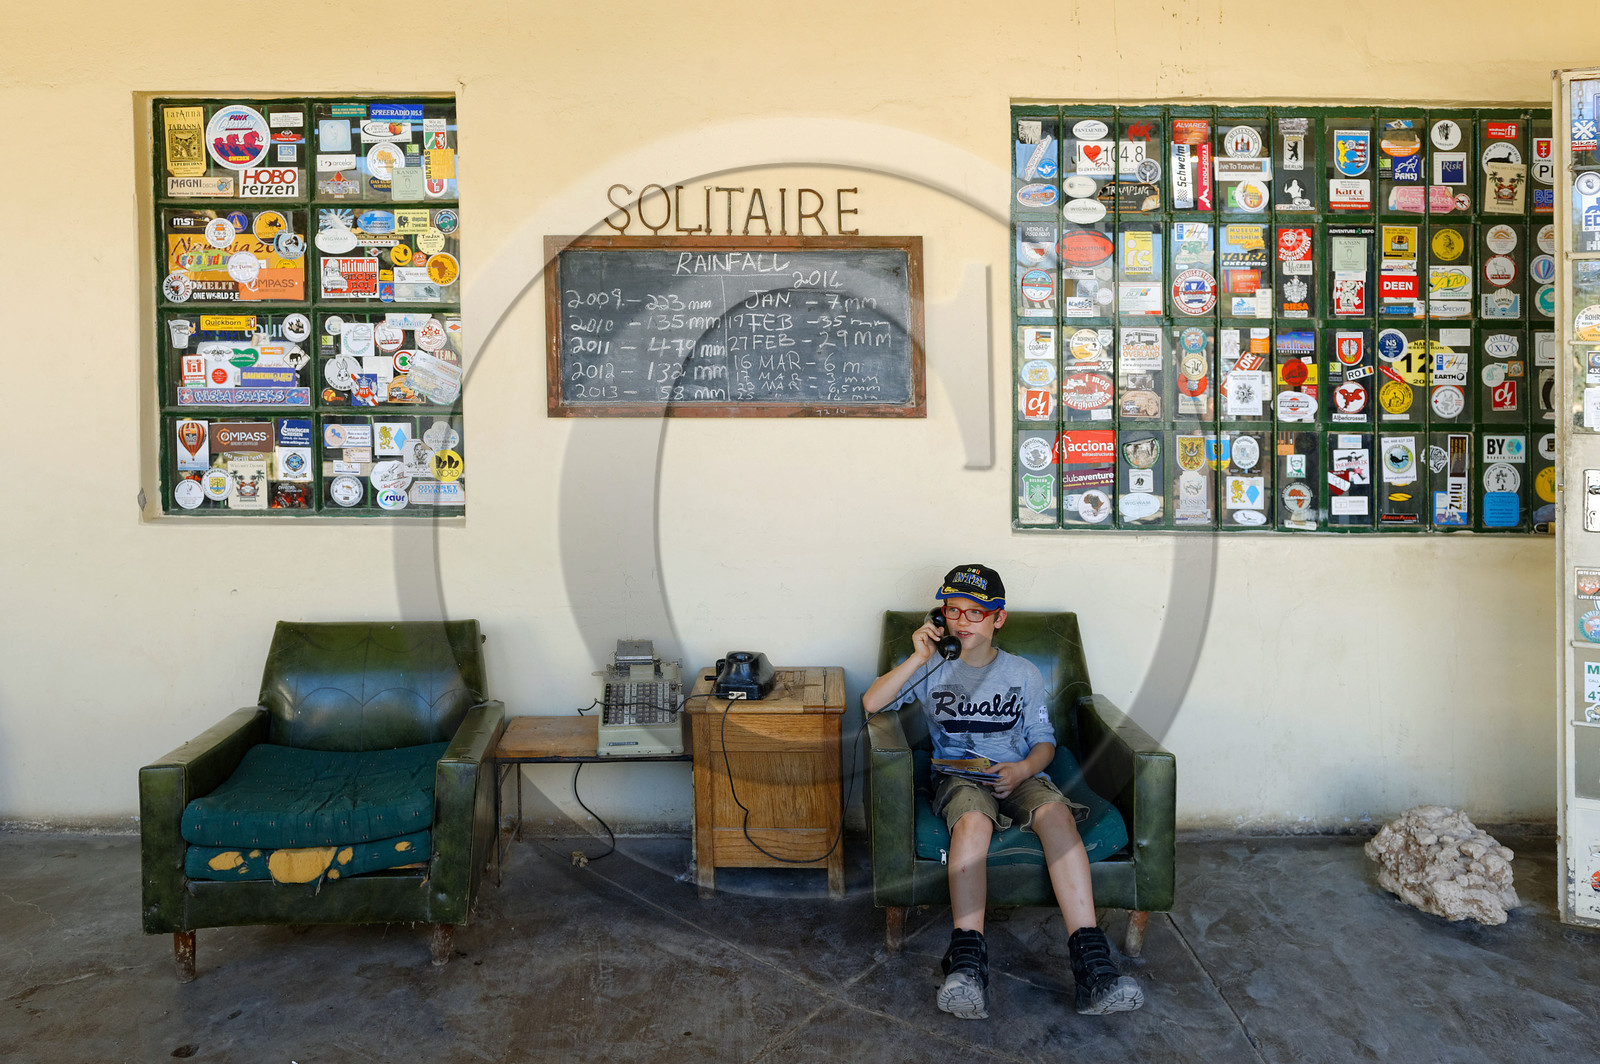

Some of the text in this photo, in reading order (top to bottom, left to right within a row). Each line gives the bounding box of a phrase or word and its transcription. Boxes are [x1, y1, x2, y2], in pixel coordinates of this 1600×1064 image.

[1177, 145, 1187, 187] Schwelm
[1442, 162, 1462, 172] Risk
[171, 179, 202, 189] MAGNI
[243, 170, 296, 184] HOBO
[242, 185, 295, 195] reizen
[603, 184, 860, 235] SOLITAIRE
[173, 218, 194, 226] msi
[675, 251, 790, 274] RAINFALL
[1222, 253, 1266, 261] TATRA
[340, 260, 377, 272] latitudini
[792, 270, 843, 289] 2014
[1384, 281, 1413, 290] DEEN
[645, 294, 686, 311] 223
[688, 299, 712, 310] mm
[844, 298, 877, 312] mm
[569, 314, 721, 334] 2010 135 mm
[745, 314, 793, 332] FEB
[820, 315, 847, 329] 35
[728, 336, 747, 351] 27
[753, 334, 796, 350] FEB
[819, 330, 848, 348] 29
[1490, 335, 1516, 343] OVALIE
[570, 336, 610, 355] 2011
[647, 337, 697, 358] 479
[734, 351, 835, 372] 16 MAR 6
[571, 362, 728, 383] 2012 132 mm
[736, 371, 879, 384] 17 MAR 3 mm
[1348, 370, 1361, 379] RO
[575, 384, 725, 400] 2013 58 mm
[761, 381, 800, 391] MAR
[235, 390, 285, 402] SHARKS
[1068, 440, 1114, 451] acciona
[1487, 439, 1505, 454] BY
[1063, 472, 1114, 483] clubaventure
[952, 571, 989, 590] INTER
